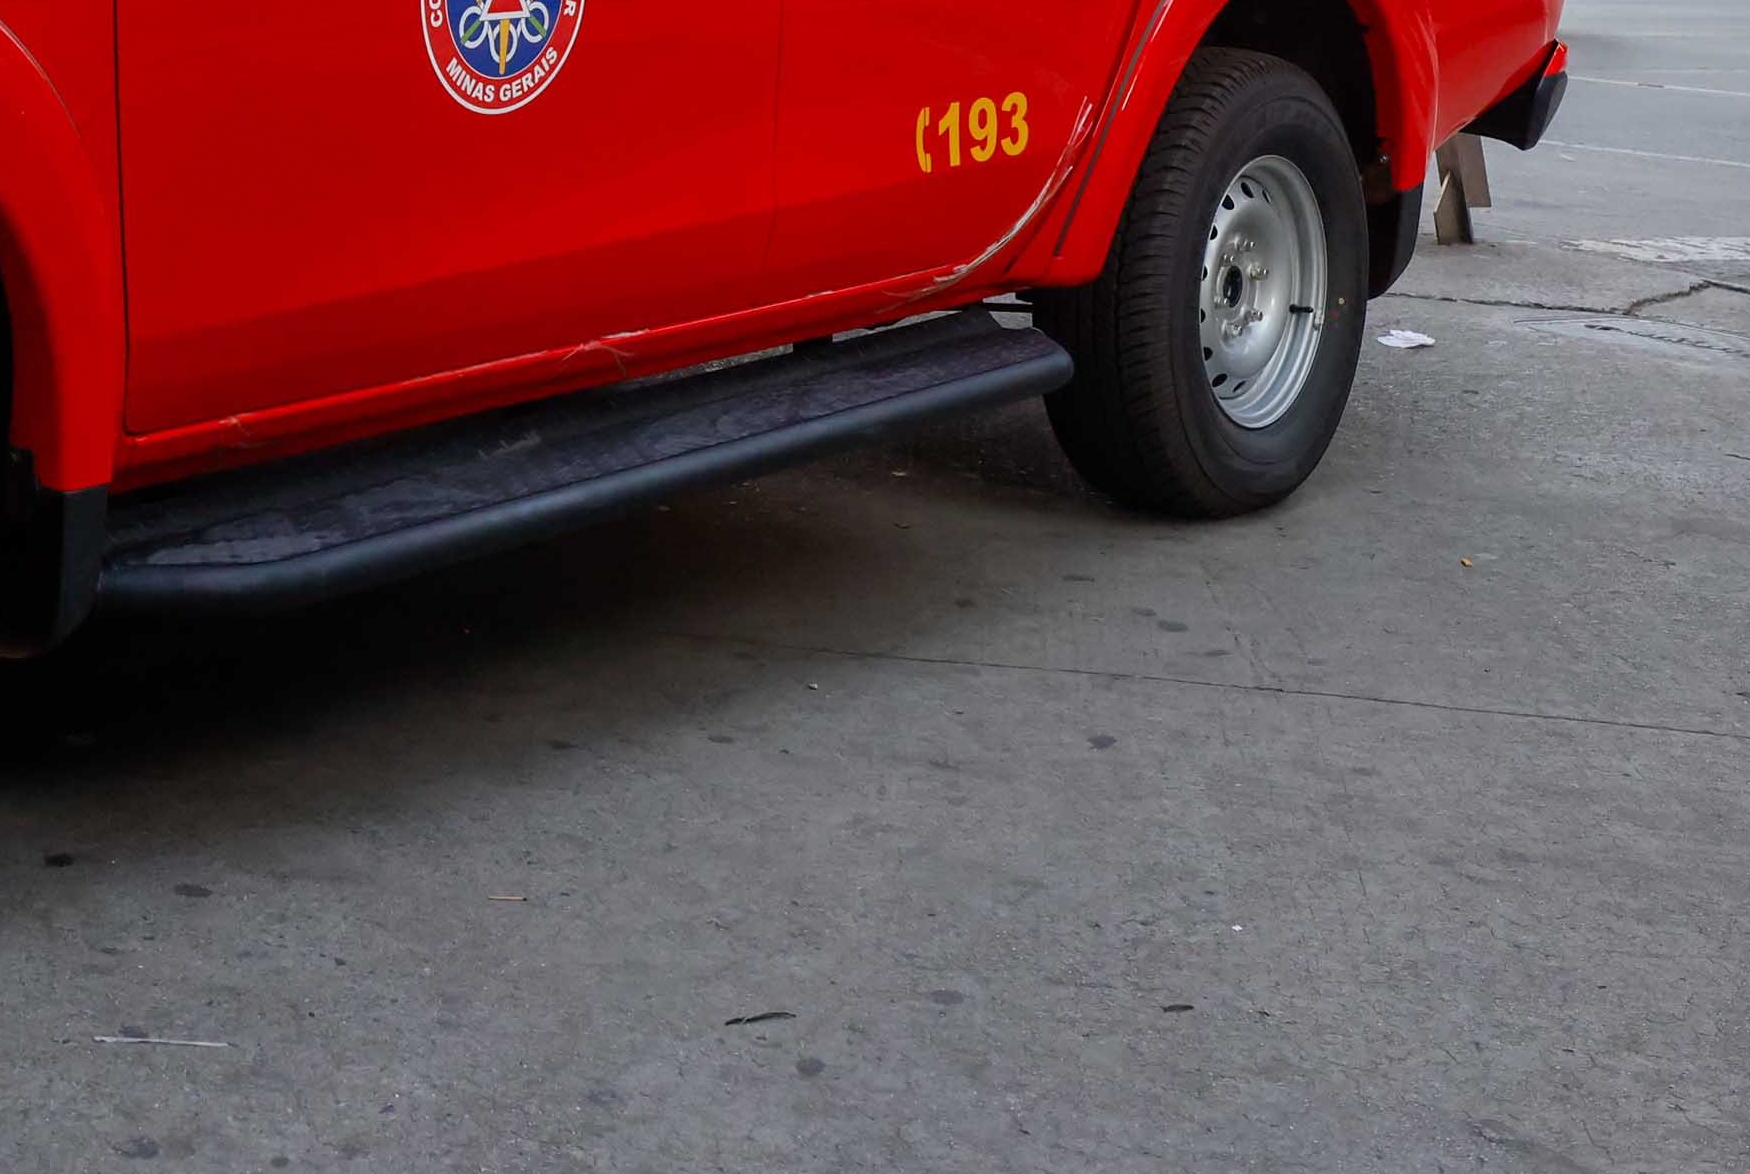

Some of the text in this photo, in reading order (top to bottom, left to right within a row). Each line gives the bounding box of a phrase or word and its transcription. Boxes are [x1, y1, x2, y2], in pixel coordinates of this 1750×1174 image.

[446, 47, 558, 103] MINAS GERAIS
[938, 91, 1029, 167] 193
